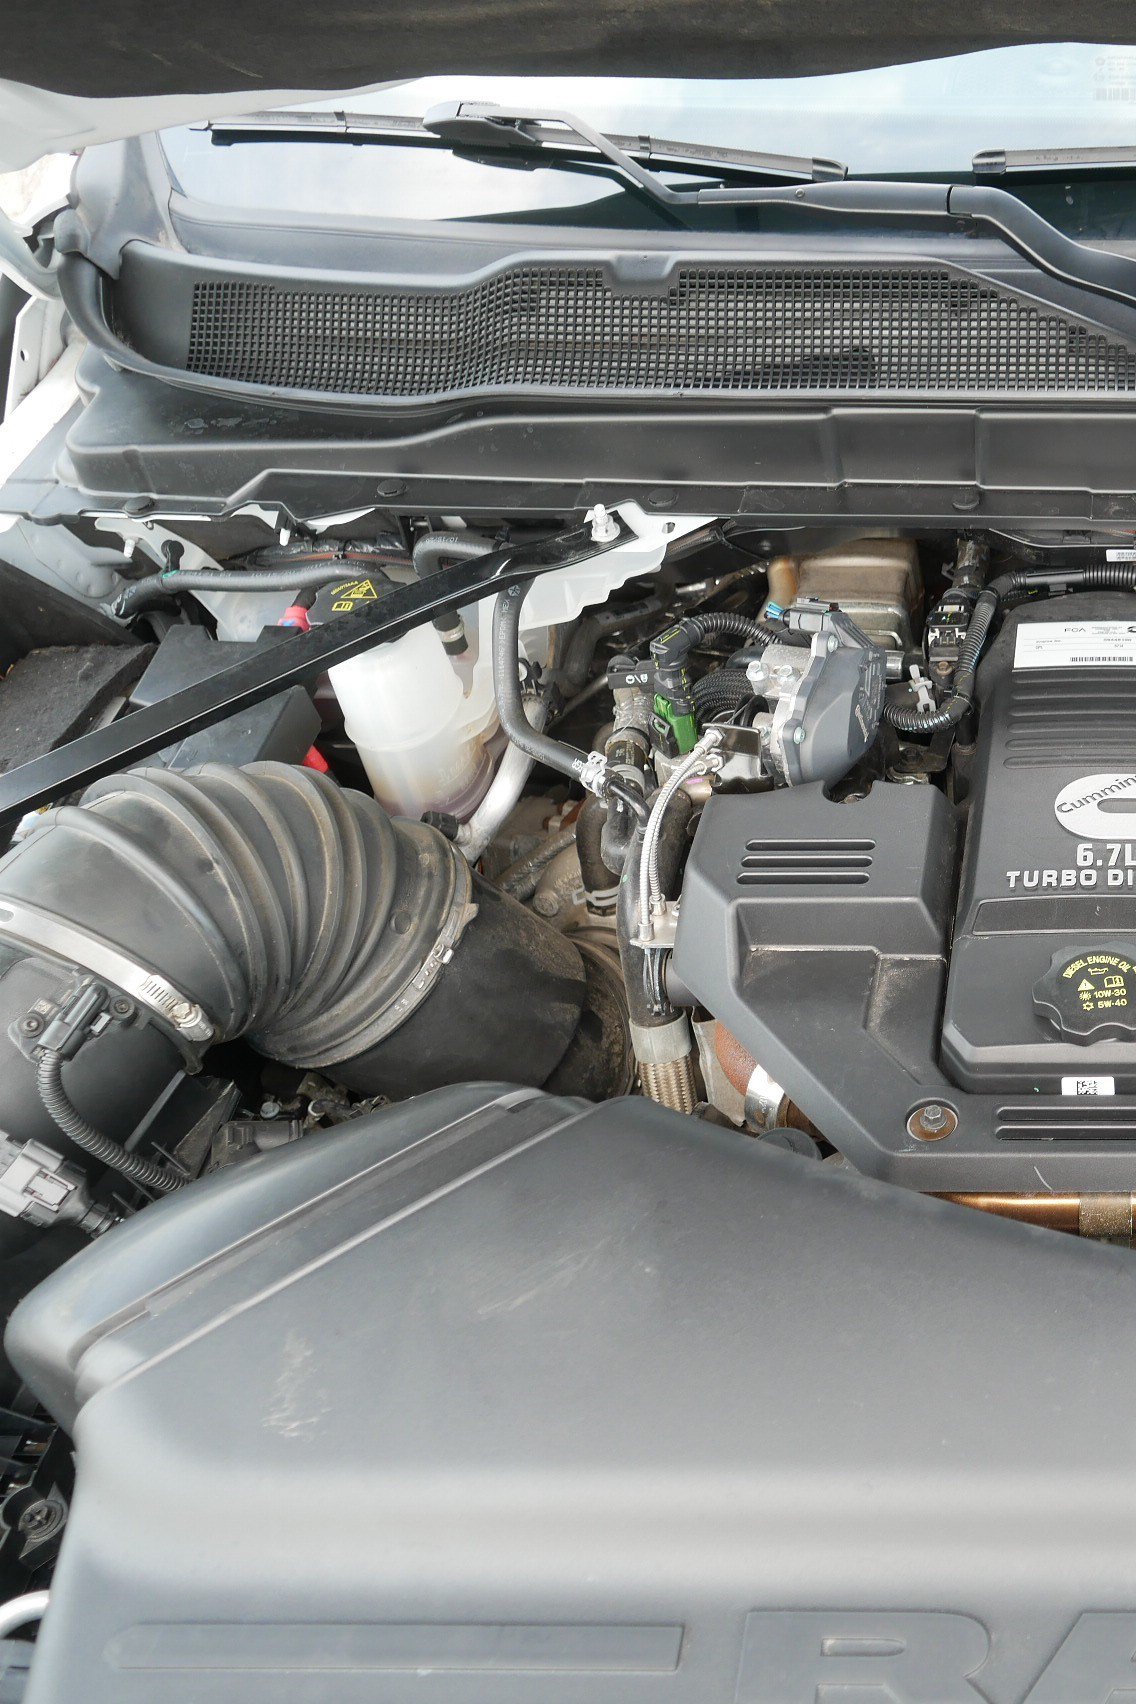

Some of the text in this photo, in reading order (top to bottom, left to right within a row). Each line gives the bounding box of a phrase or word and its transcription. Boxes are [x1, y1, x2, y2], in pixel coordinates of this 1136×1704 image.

[1006, 869, 1098, 889] TURBO
[1062, 959, 1088, 980] DIESEL
[1087, 955, 1120, 966] ENGINE
[1118, 960, 1133, 973] OIL
[1094, 988, 1127, 999] 10W-30
[1097, 998, 1128, 1008] 5W-40
